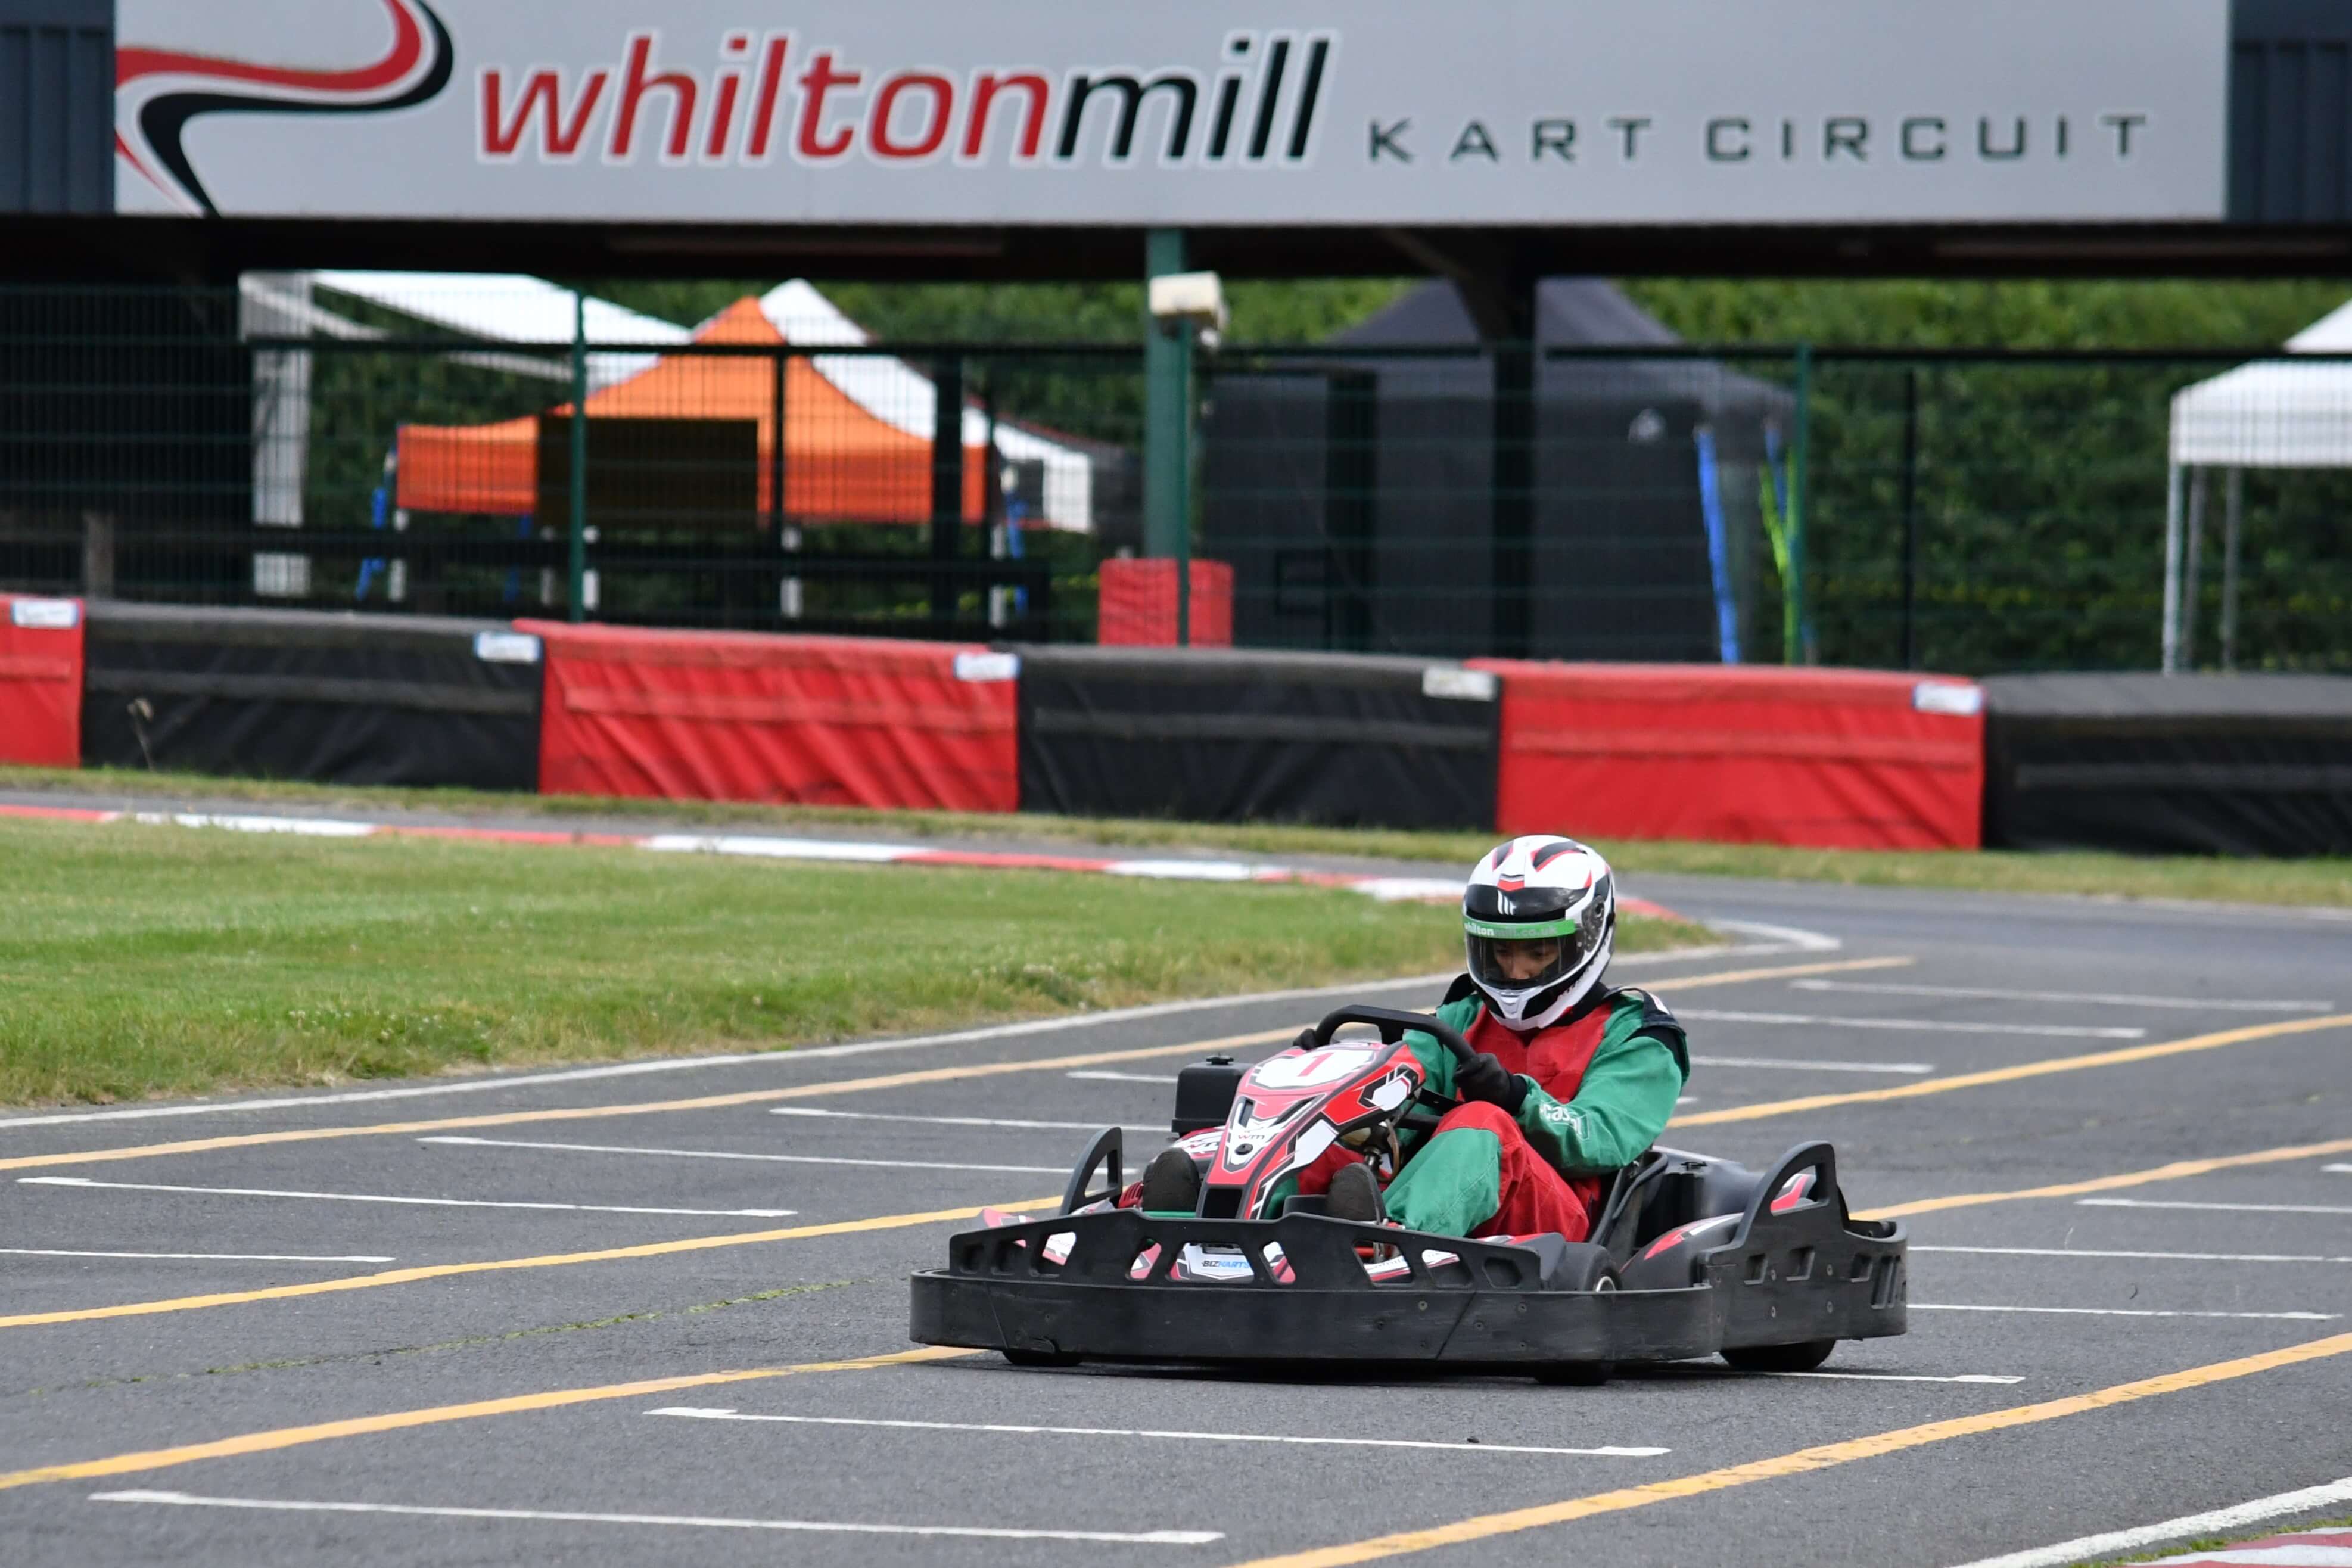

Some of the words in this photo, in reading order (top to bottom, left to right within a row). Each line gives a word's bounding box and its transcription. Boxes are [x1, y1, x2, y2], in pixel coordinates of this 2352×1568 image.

[481, 36, 1330, 160] whiltonmill
[1369, 118, 1651, 162] KART
[1706, 116, 2146, 162] CIRCUIT
[1297, 1052, 1335, 1077] 1
